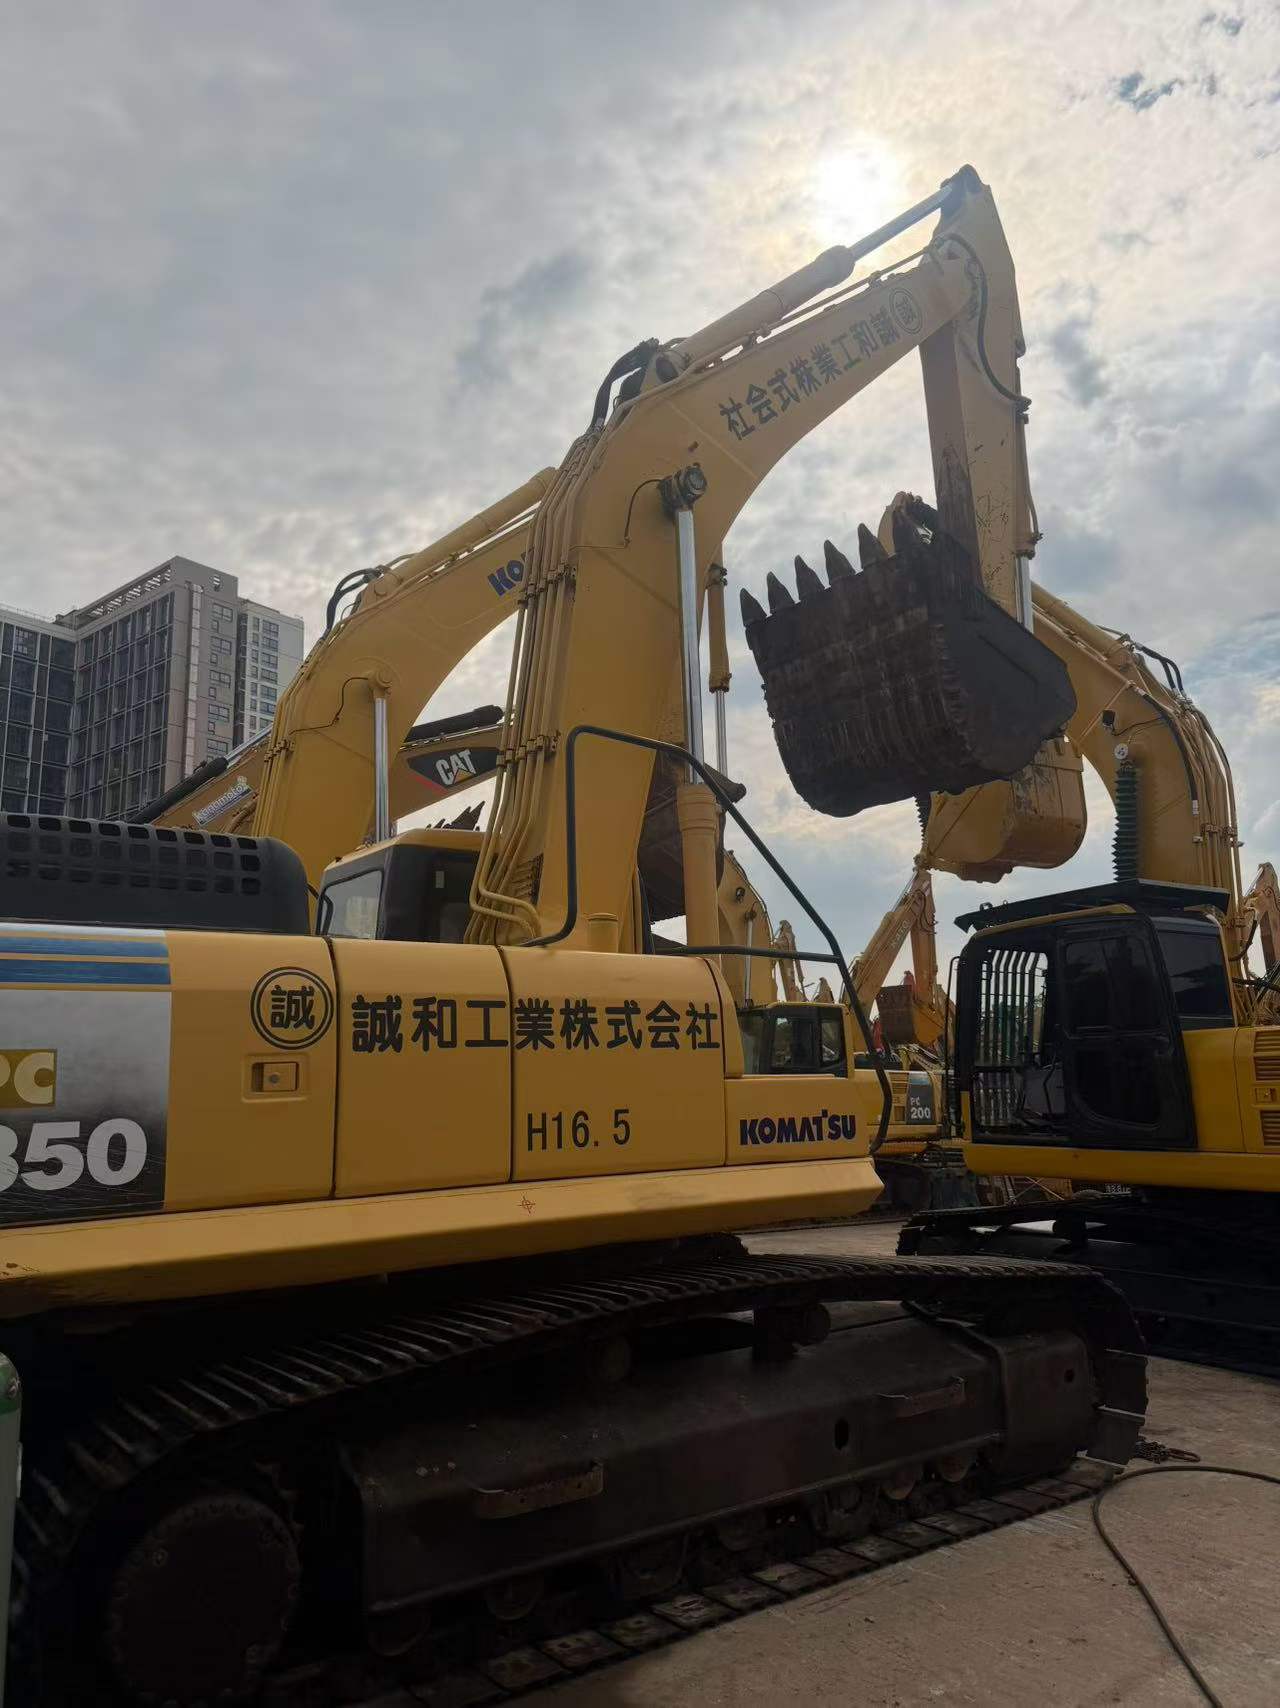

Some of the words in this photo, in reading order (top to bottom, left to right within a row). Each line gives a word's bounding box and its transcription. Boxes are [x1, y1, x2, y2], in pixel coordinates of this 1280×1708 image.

[488, 552, 526, 597] KO
[435, 749, 476, 785] CAT
[351, 994, 721, 1053] 誠和工業株式会社
[0, 1051, 55, 1105] C
[740, 1109, 857, 1146] KOMATSU
[911, 1107, 931, 1119] 200
